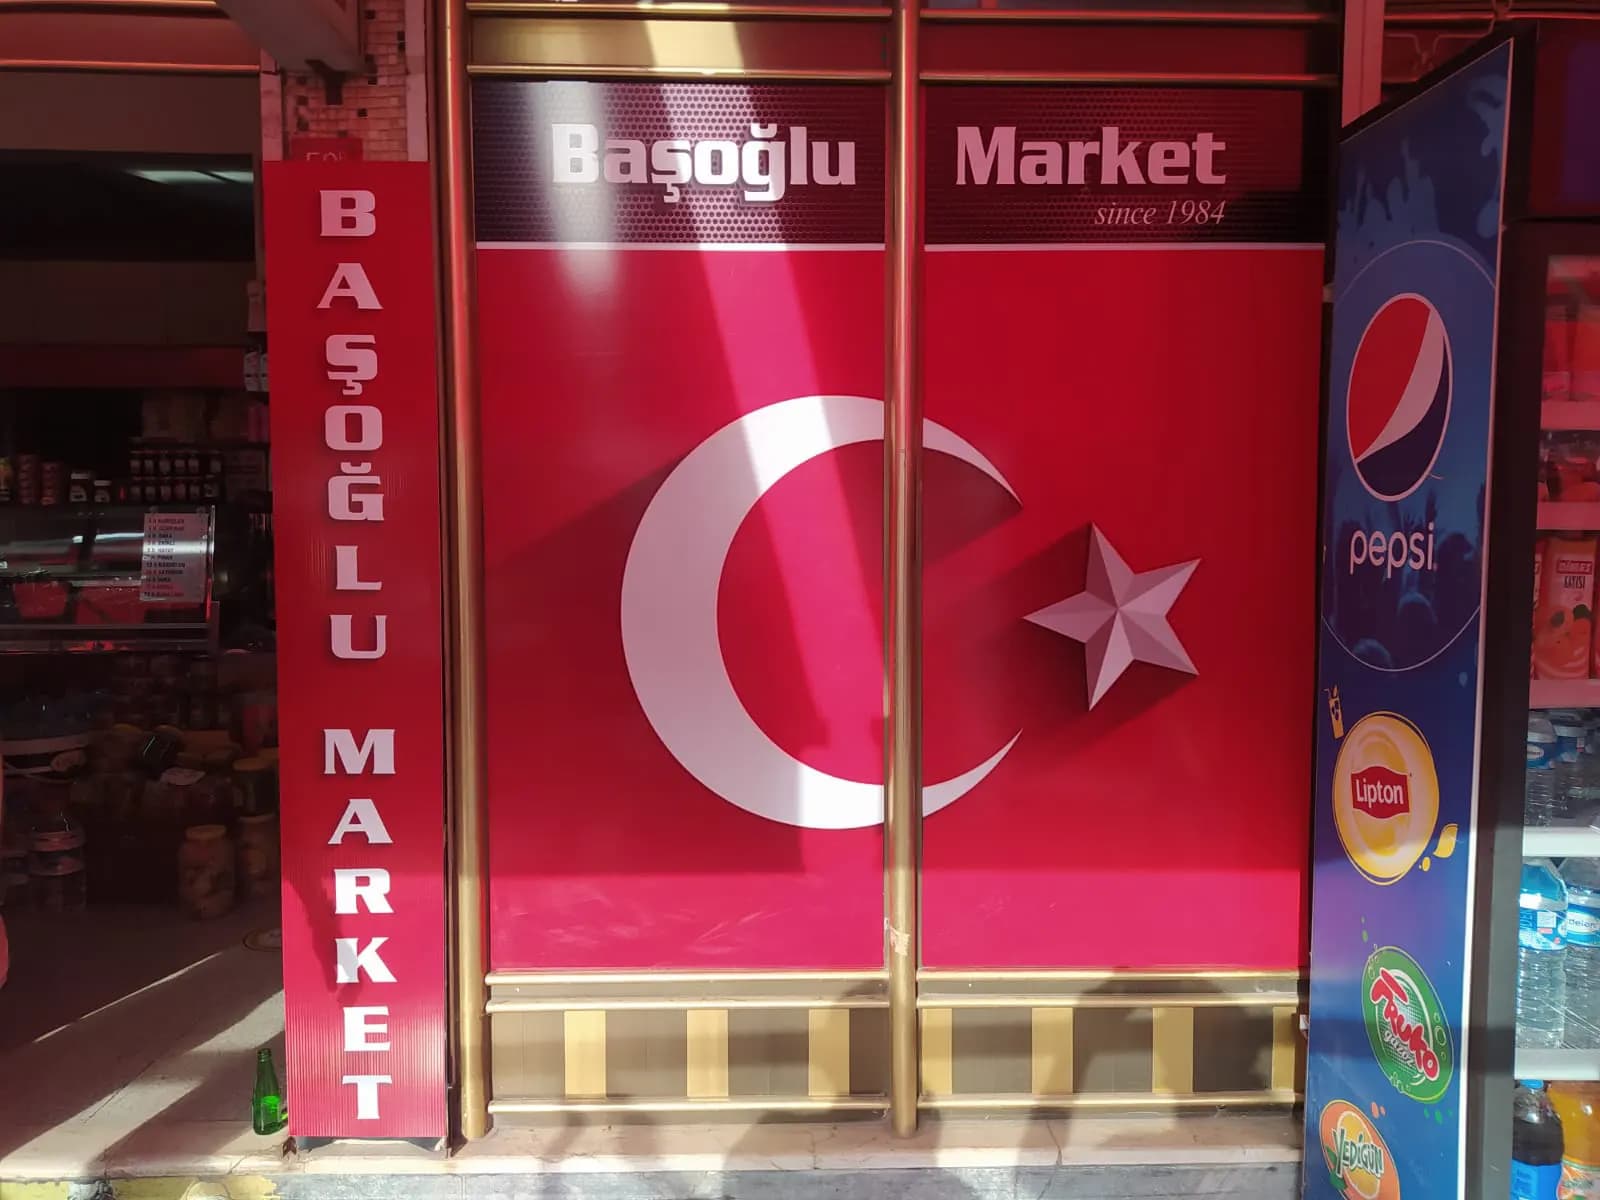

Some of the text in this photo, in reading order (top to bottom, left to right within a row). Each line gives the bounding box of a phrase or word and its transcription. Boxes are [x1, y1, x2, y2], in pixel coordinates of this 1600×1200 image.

[551, 123, 1227, 203] Başoğlu Market
[1094, 199, 1226, 226] since 1984
[317, 189, 387, 660] BAŞOĞLU
[1349, 521, 1435, 579] pepsi
[1355, 777, 1404, 809] Lipton
[323, 728, 396, 1120] MARKET
